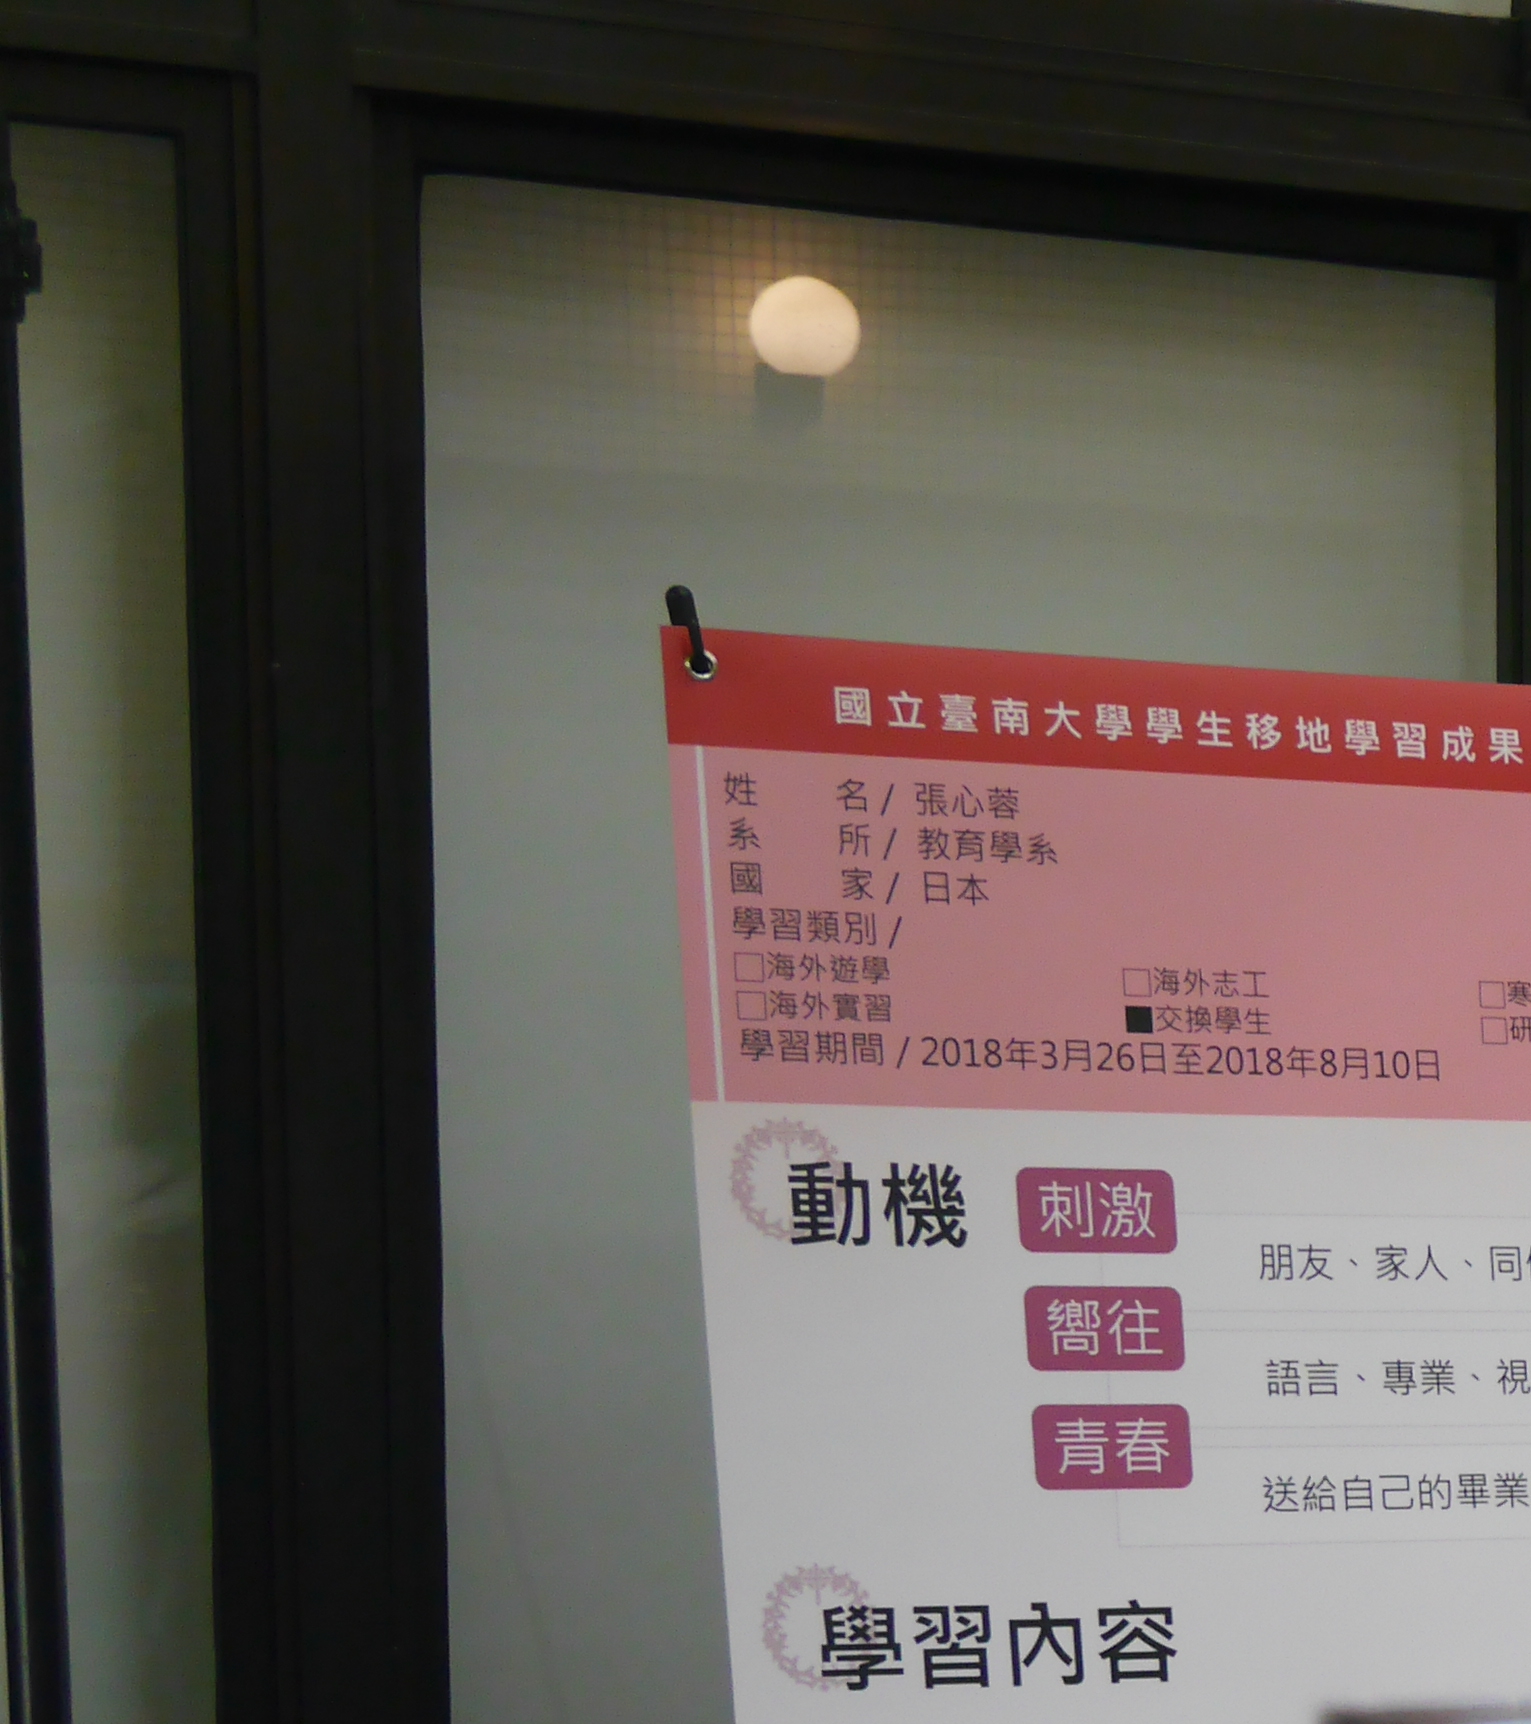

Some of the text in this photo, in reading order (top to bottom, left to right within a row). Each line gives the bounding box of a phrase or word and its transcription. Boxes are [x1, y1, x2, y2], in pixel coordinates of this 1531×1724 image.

[915, 783, 1020, 820] 張心蓉
[918, 827, 1058, 865] 教育學系
[923, 872, 990, 906] 日本
[732, 905, 877, 947] 學習類別
[767, 952, 890, 985] 海外遊學
[1154, 968, 1268, 998] 海外志工
[769, 990, 892, 1024] 海外實習
[1155, 1006, 1272, 1037] 交換學生
[740, 1028, 884, 1066] 學習期間
[921, 1036, 1441, 1083] 2018年3月26日至2018年8月10日
[788, 1161, 968, 1249] 動機
[1037, 1180, 1156, 1241] 刺激
[1046, 1297, 1162, 1357] 嚮往
[1054, 1417, 1171, 1475] 青春
[820, 1599, 1178, 1691] 學習內容
